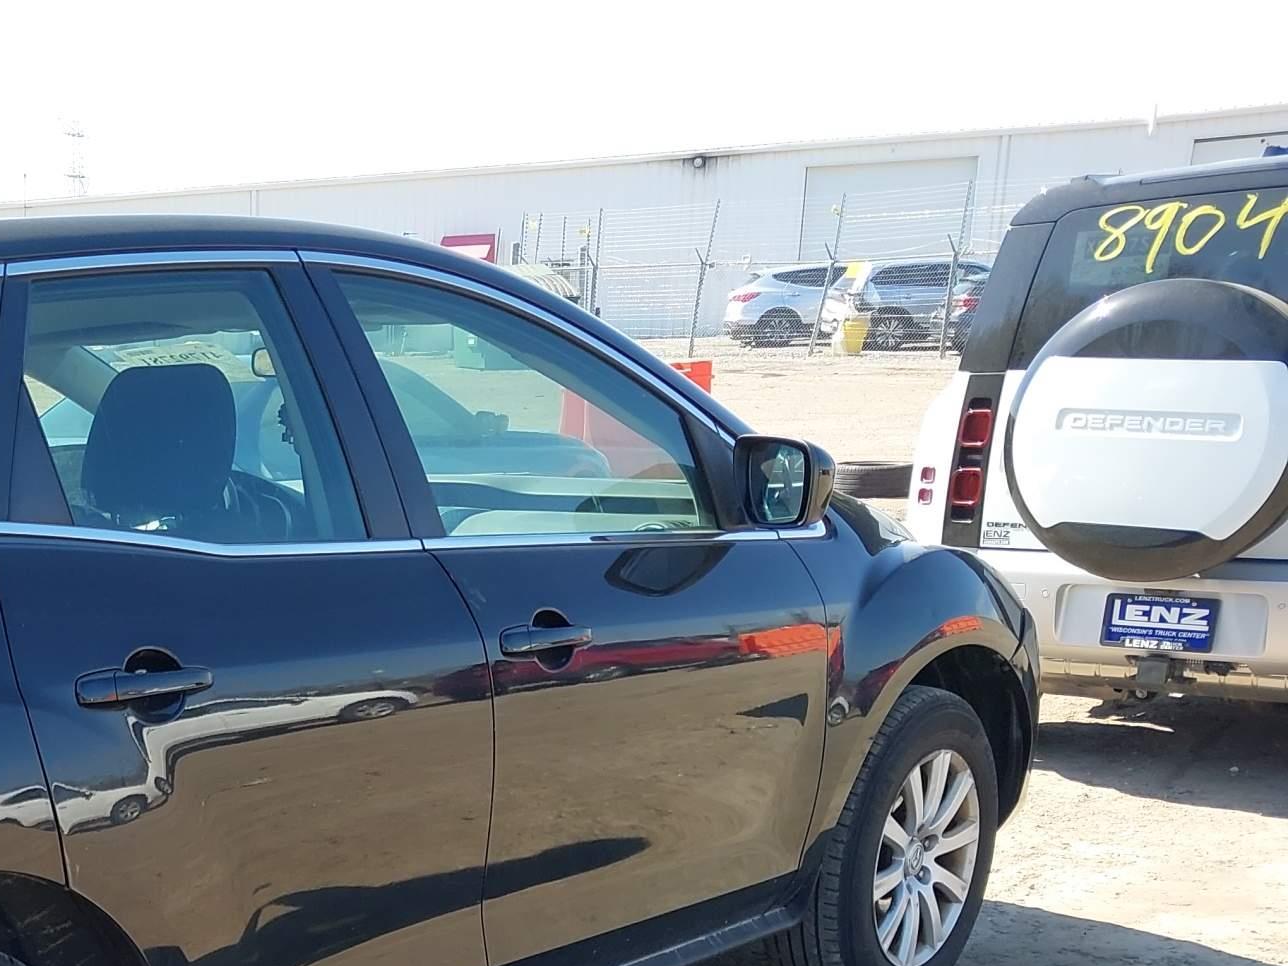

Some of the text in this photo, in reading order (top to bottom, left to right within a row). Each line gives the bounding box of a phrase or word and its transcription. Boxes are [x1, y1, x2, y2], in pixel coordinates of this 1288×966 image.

[1069, 413, 1227, 434] DEFENDER
[1134, 595, 1191, 604] LENZTRUCK.COM
[1111, 599, 1210, 632] LENZ
[1154, 629, 1177, 638] TRUCK
[1124, 638, 1158, 649] LENZ
